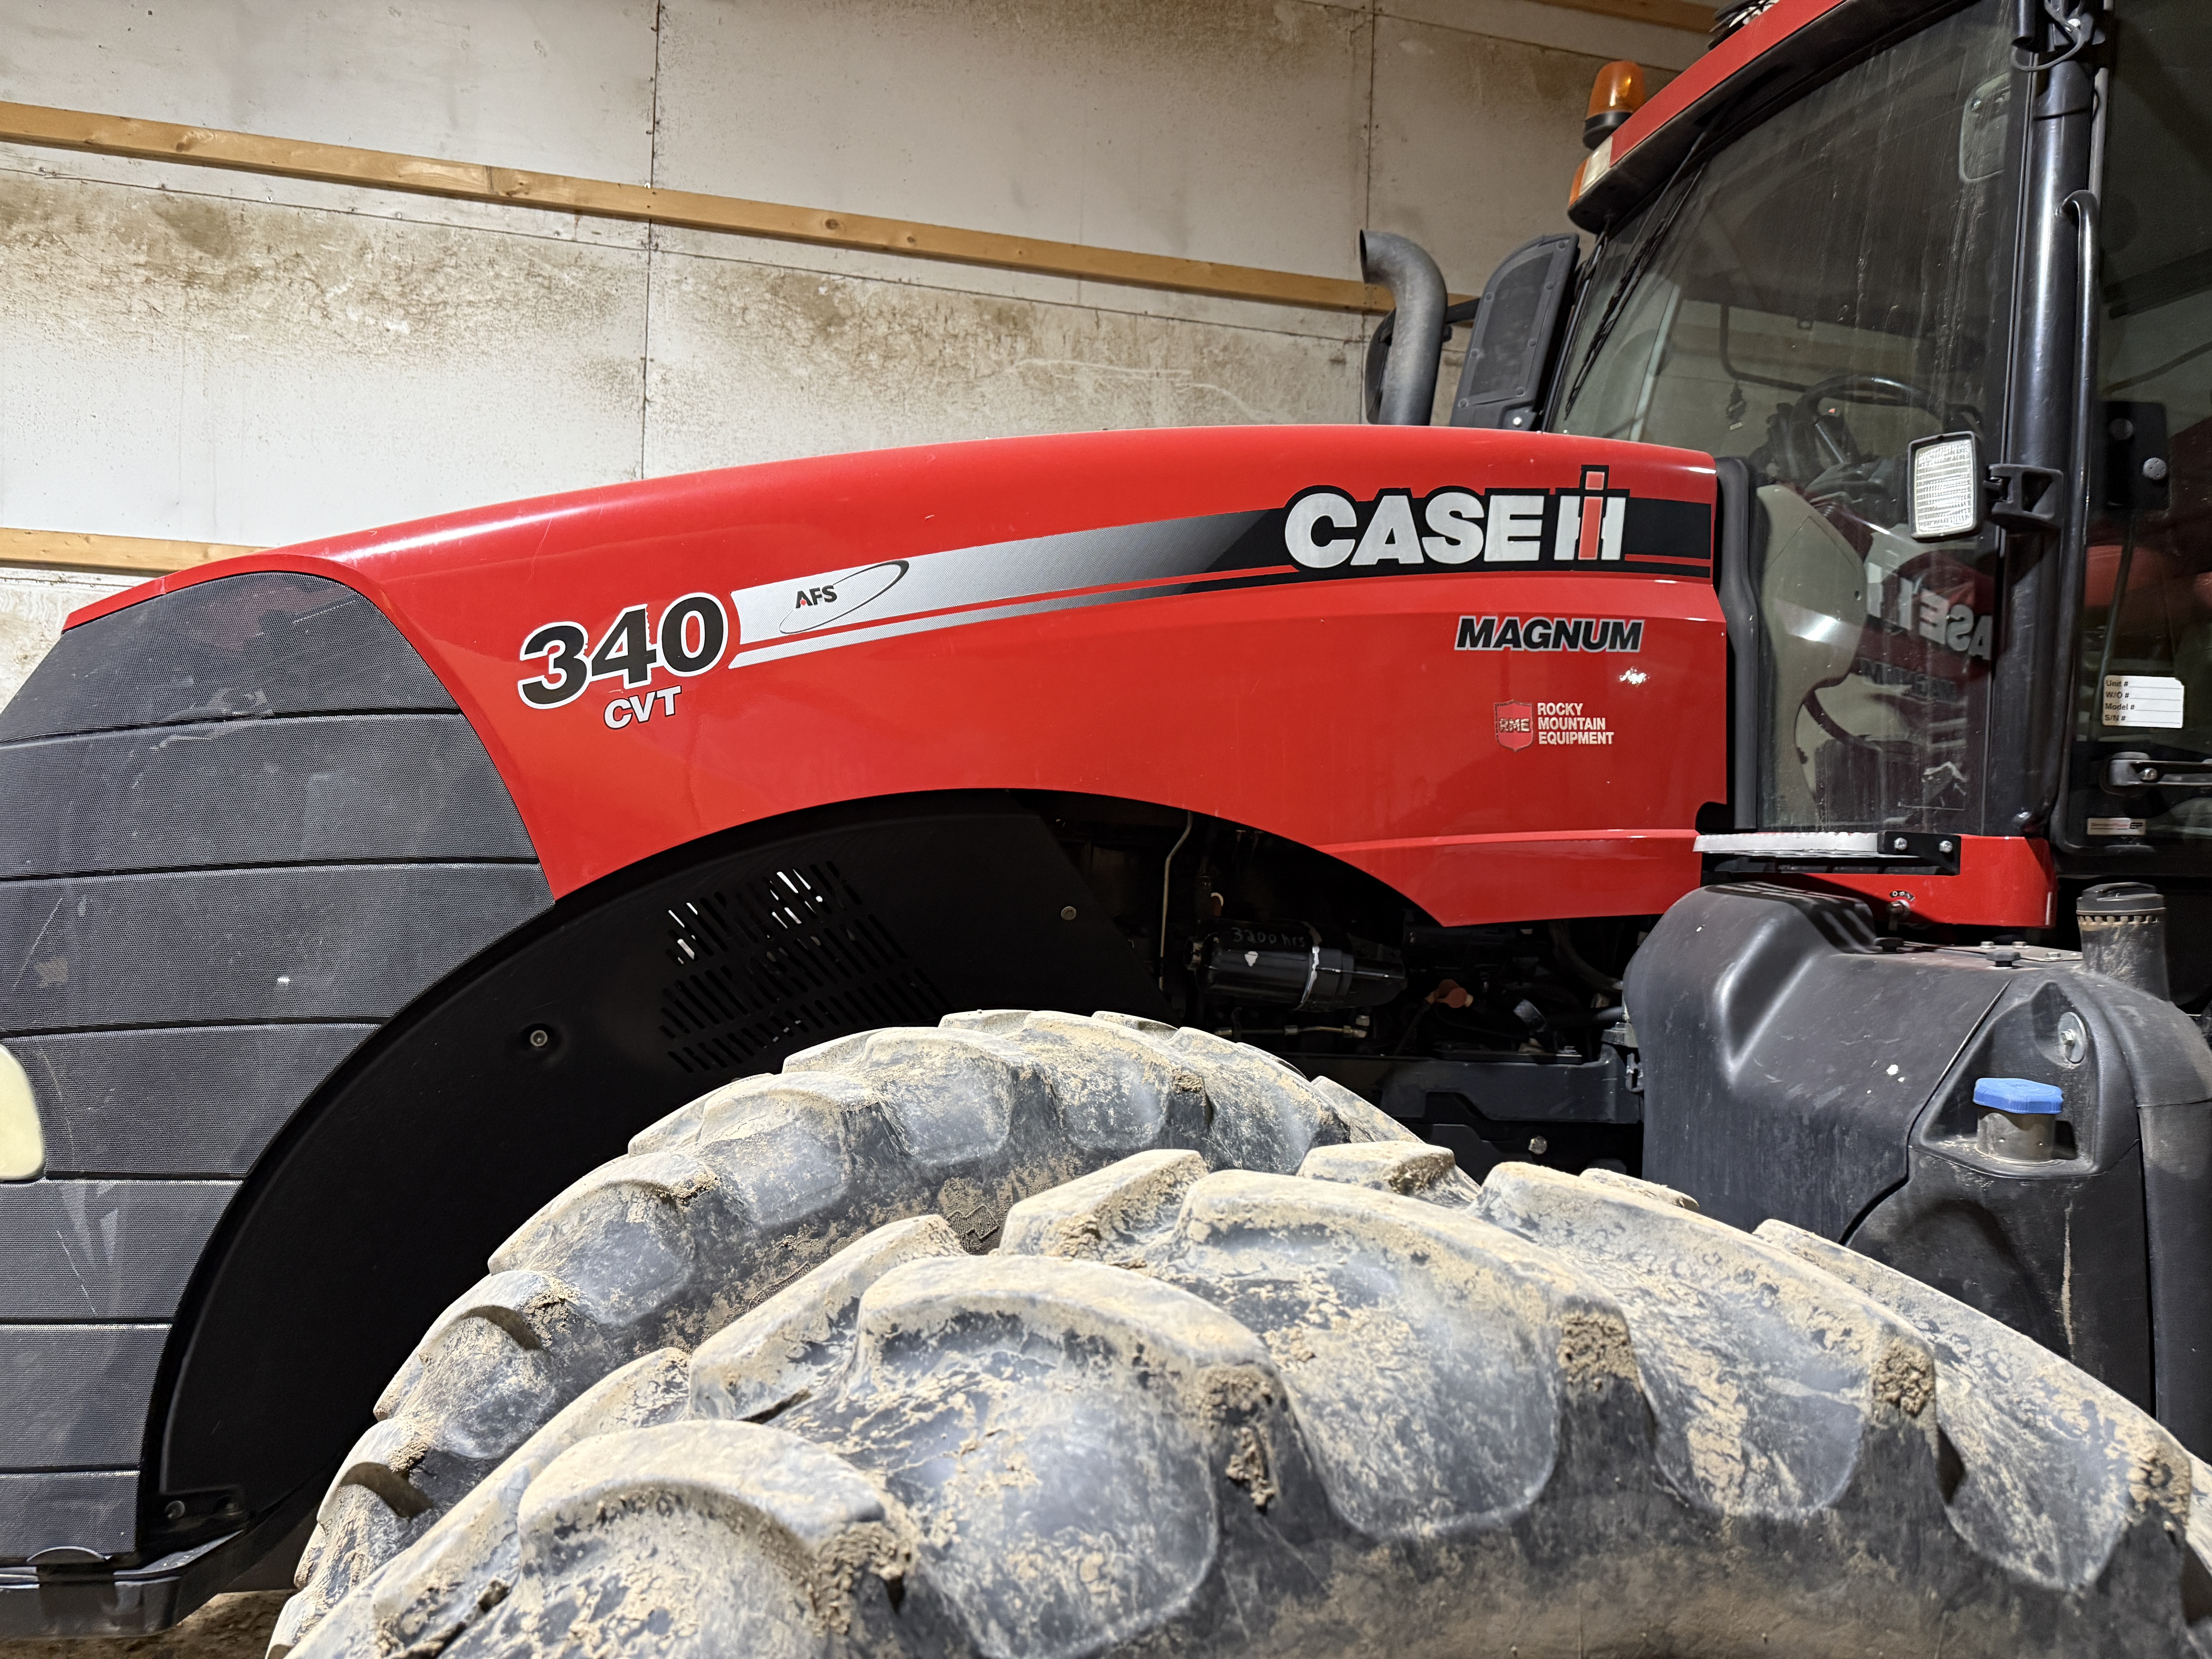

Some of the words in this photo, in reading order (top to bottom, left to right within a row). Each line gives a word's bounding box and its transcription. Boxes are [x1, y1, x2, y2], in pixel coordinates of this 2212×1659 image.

[1284, 491, 1545, 568] CASE
[1553, 471, 1627, 561] IH
[795, 585, 837, 609] AFS
[1455, 615, 1644, 653] MAGNUM
[517, 592, 728, 709] 340
[603, 685, 682, 730] CVT
[1537, 702, 1583, 716] ROCKY
[1499, 718, 1530, 732] RME
[1538, 717, 1606, 730] MOUNTAIN
[1539, 731, 1614, 745] EQUIPMENT
[1230, 927, 1277, 944] 3200
[1281, 933, 1305, 947] hrs
